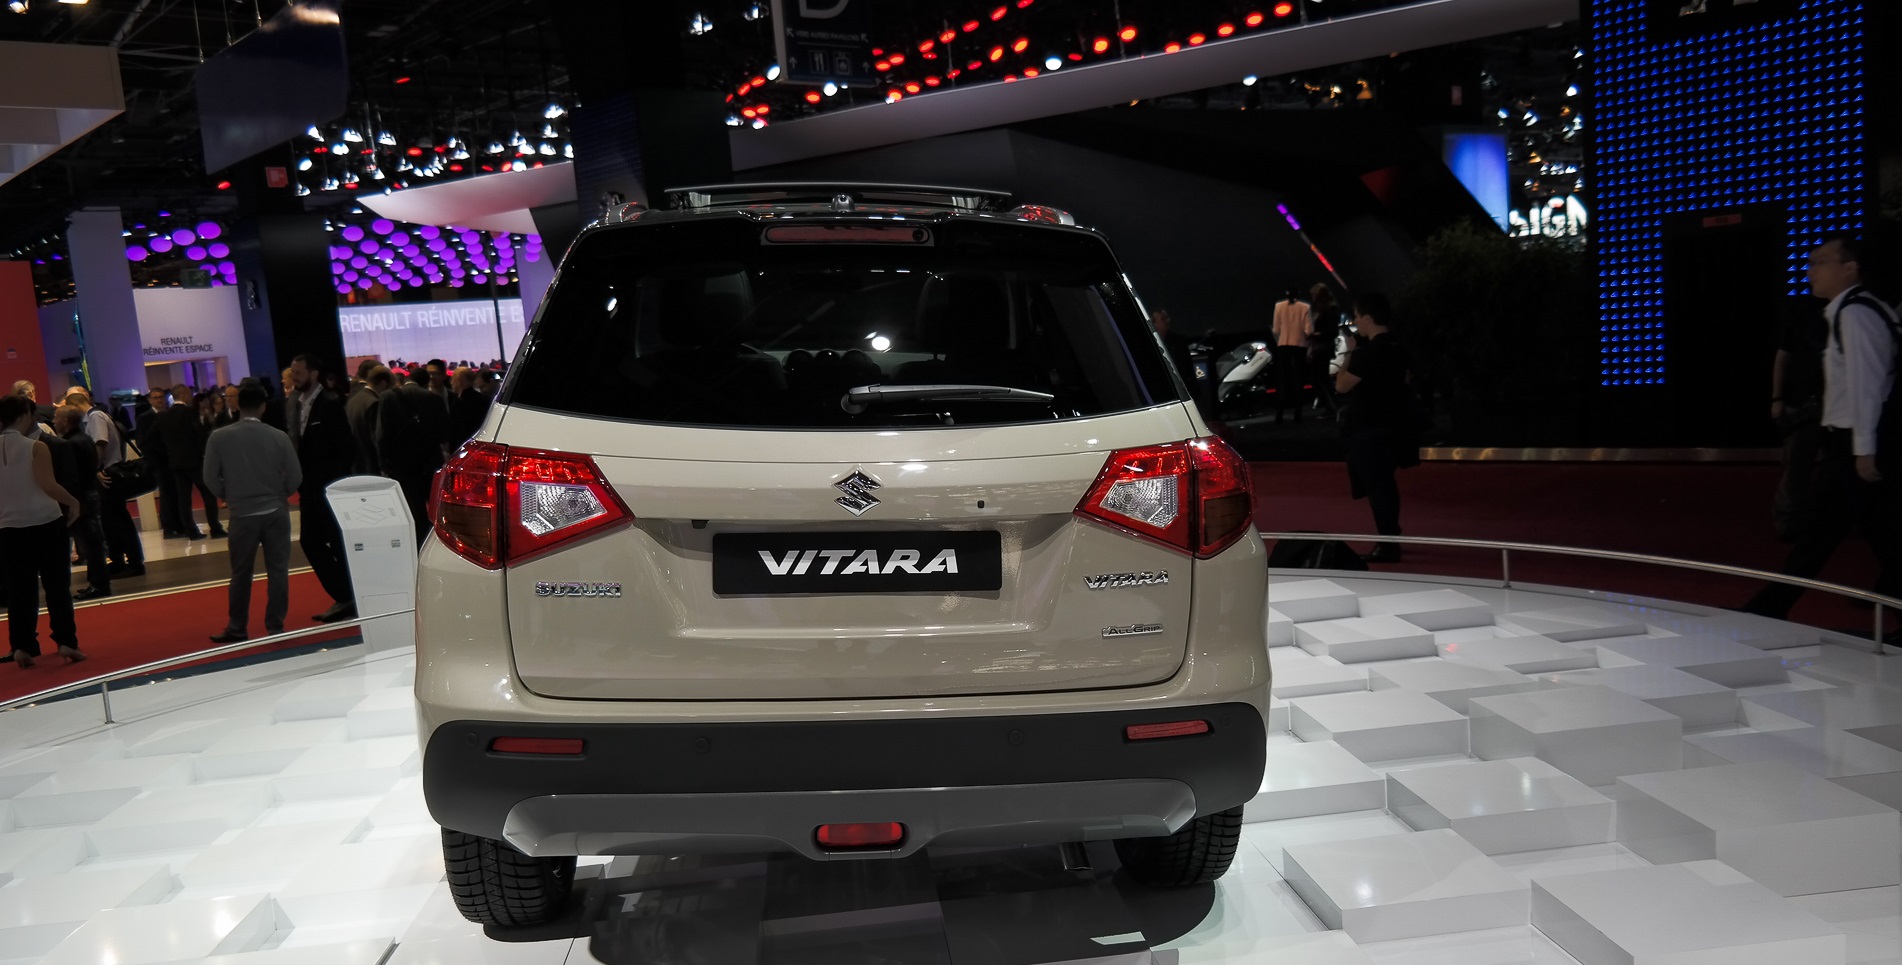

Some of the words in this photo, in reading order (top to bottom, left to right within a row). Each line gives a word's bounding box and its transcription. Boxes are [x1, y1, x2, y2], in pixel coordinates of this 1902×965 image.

[340, 311, 412, 333] RENAULT
[418, 306, 507, 328] RÉINVENTE
[143, 345, 184, 356] RÉINVENTE
[185, 344, 213, 354] ESPACE
[160, 336, 193, 346] RENAULT
[758, 548, 959, 575] VITARA
[1084, 569, 1169, 589] VITARA
[535, 581, 622, 597] SUZUKI
